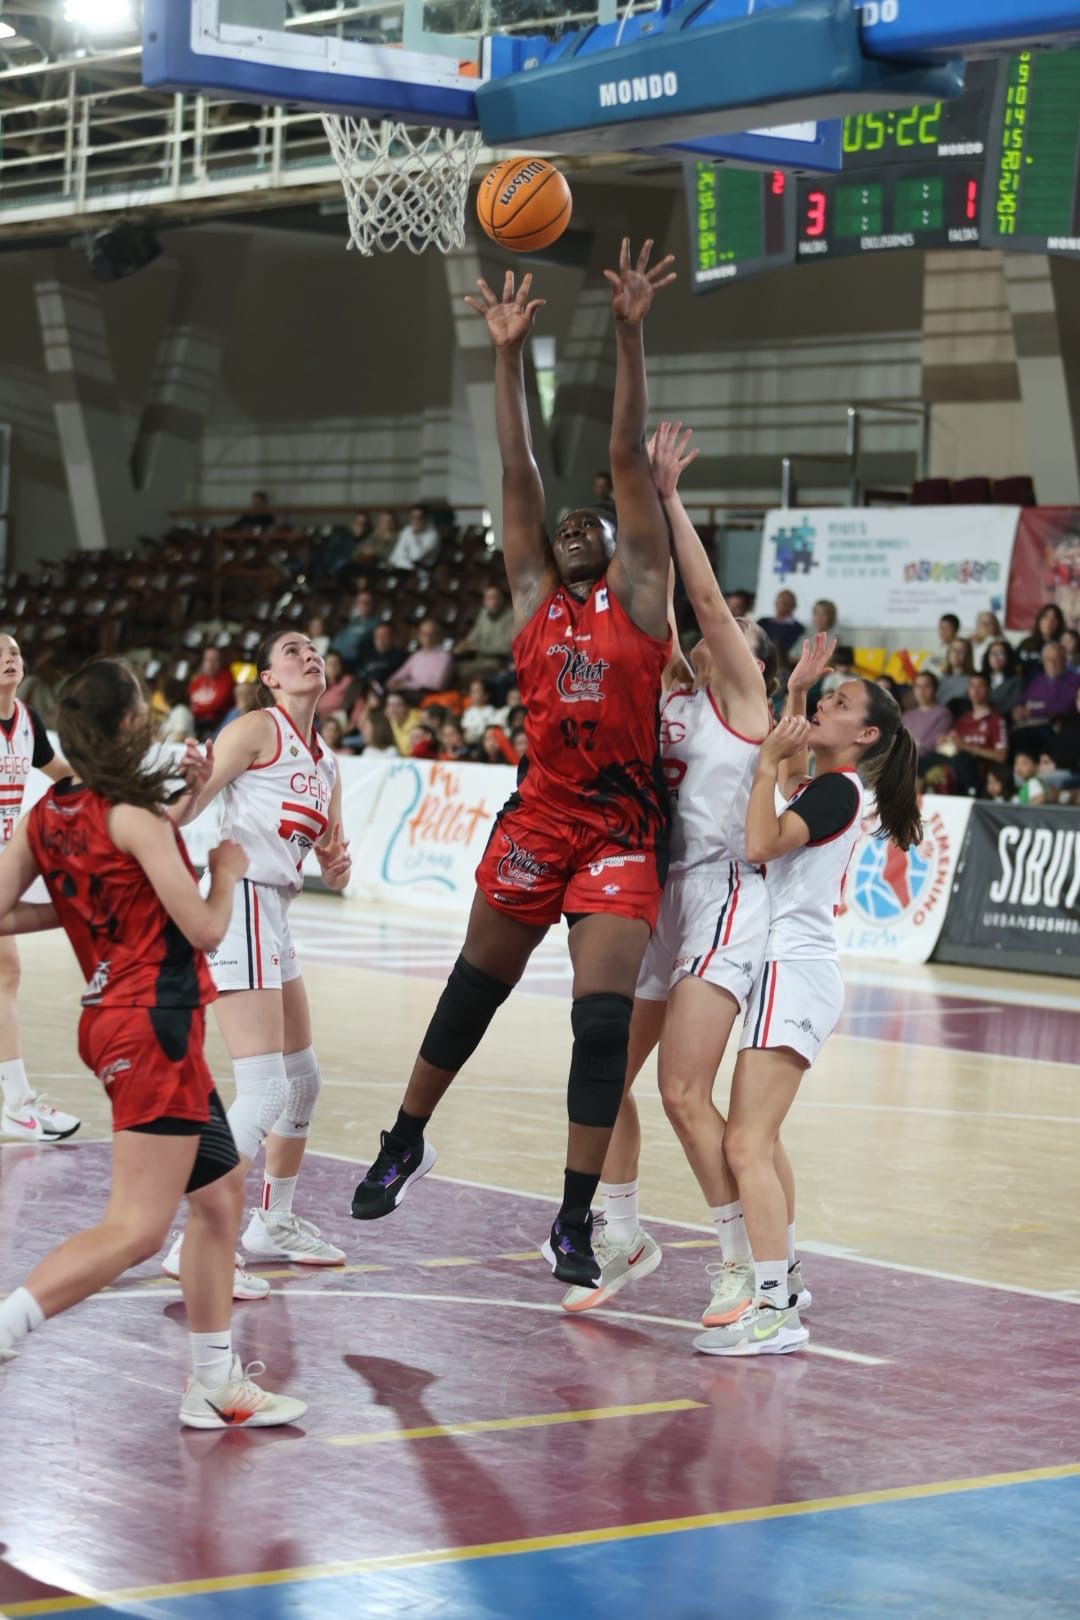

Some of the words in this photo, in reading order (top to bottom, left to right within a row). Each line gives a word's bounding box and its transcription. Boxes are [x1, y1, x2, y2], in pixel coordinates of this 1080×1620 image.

[854, 0, 899, 27] DO
[599, 71, 678, 107] MONDO
[938, 142, 984, 157] MONDO
[499, 161, 547, 206] Wilson
[966, 180, 977, 220] 1
[805, 191, 827, 237] 3
[763, 1279, 779, 1287] NIKE
